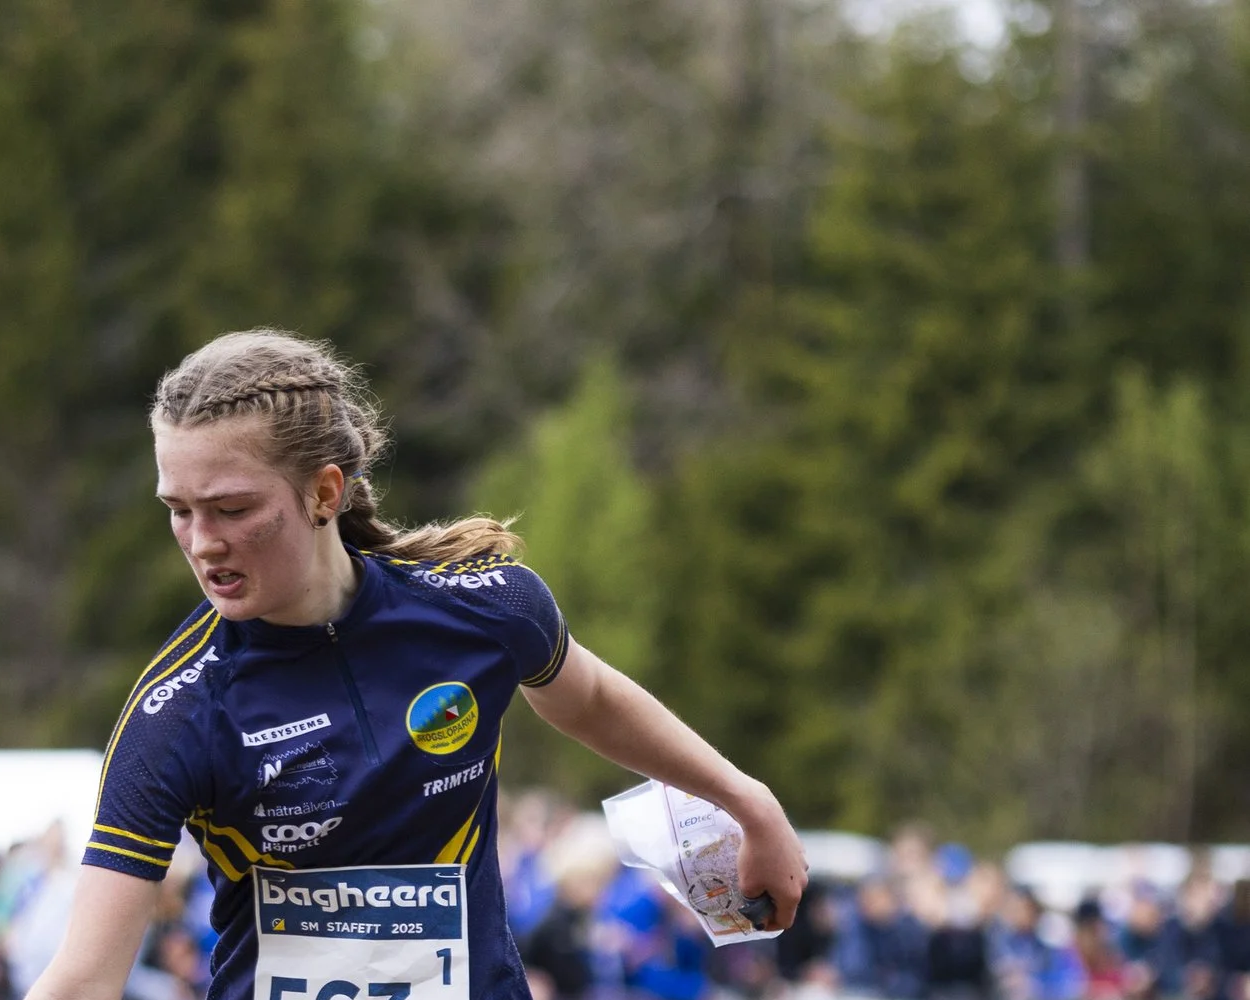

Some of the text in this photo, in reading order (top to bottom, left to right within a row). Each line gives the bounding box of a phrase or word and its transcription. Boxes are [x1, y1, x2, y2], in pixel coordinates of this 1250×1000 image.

[271, 717, 324, 739] SYSTEMS
[422, 759, 485, 797] TRIMTEX
[267, 800, 335, 817] nätraälven
[261, 878, 457, 913] bagheera
[301, 921, 423, 934] SM STAFETT 2025
[435, 947, 452, 986] 1
